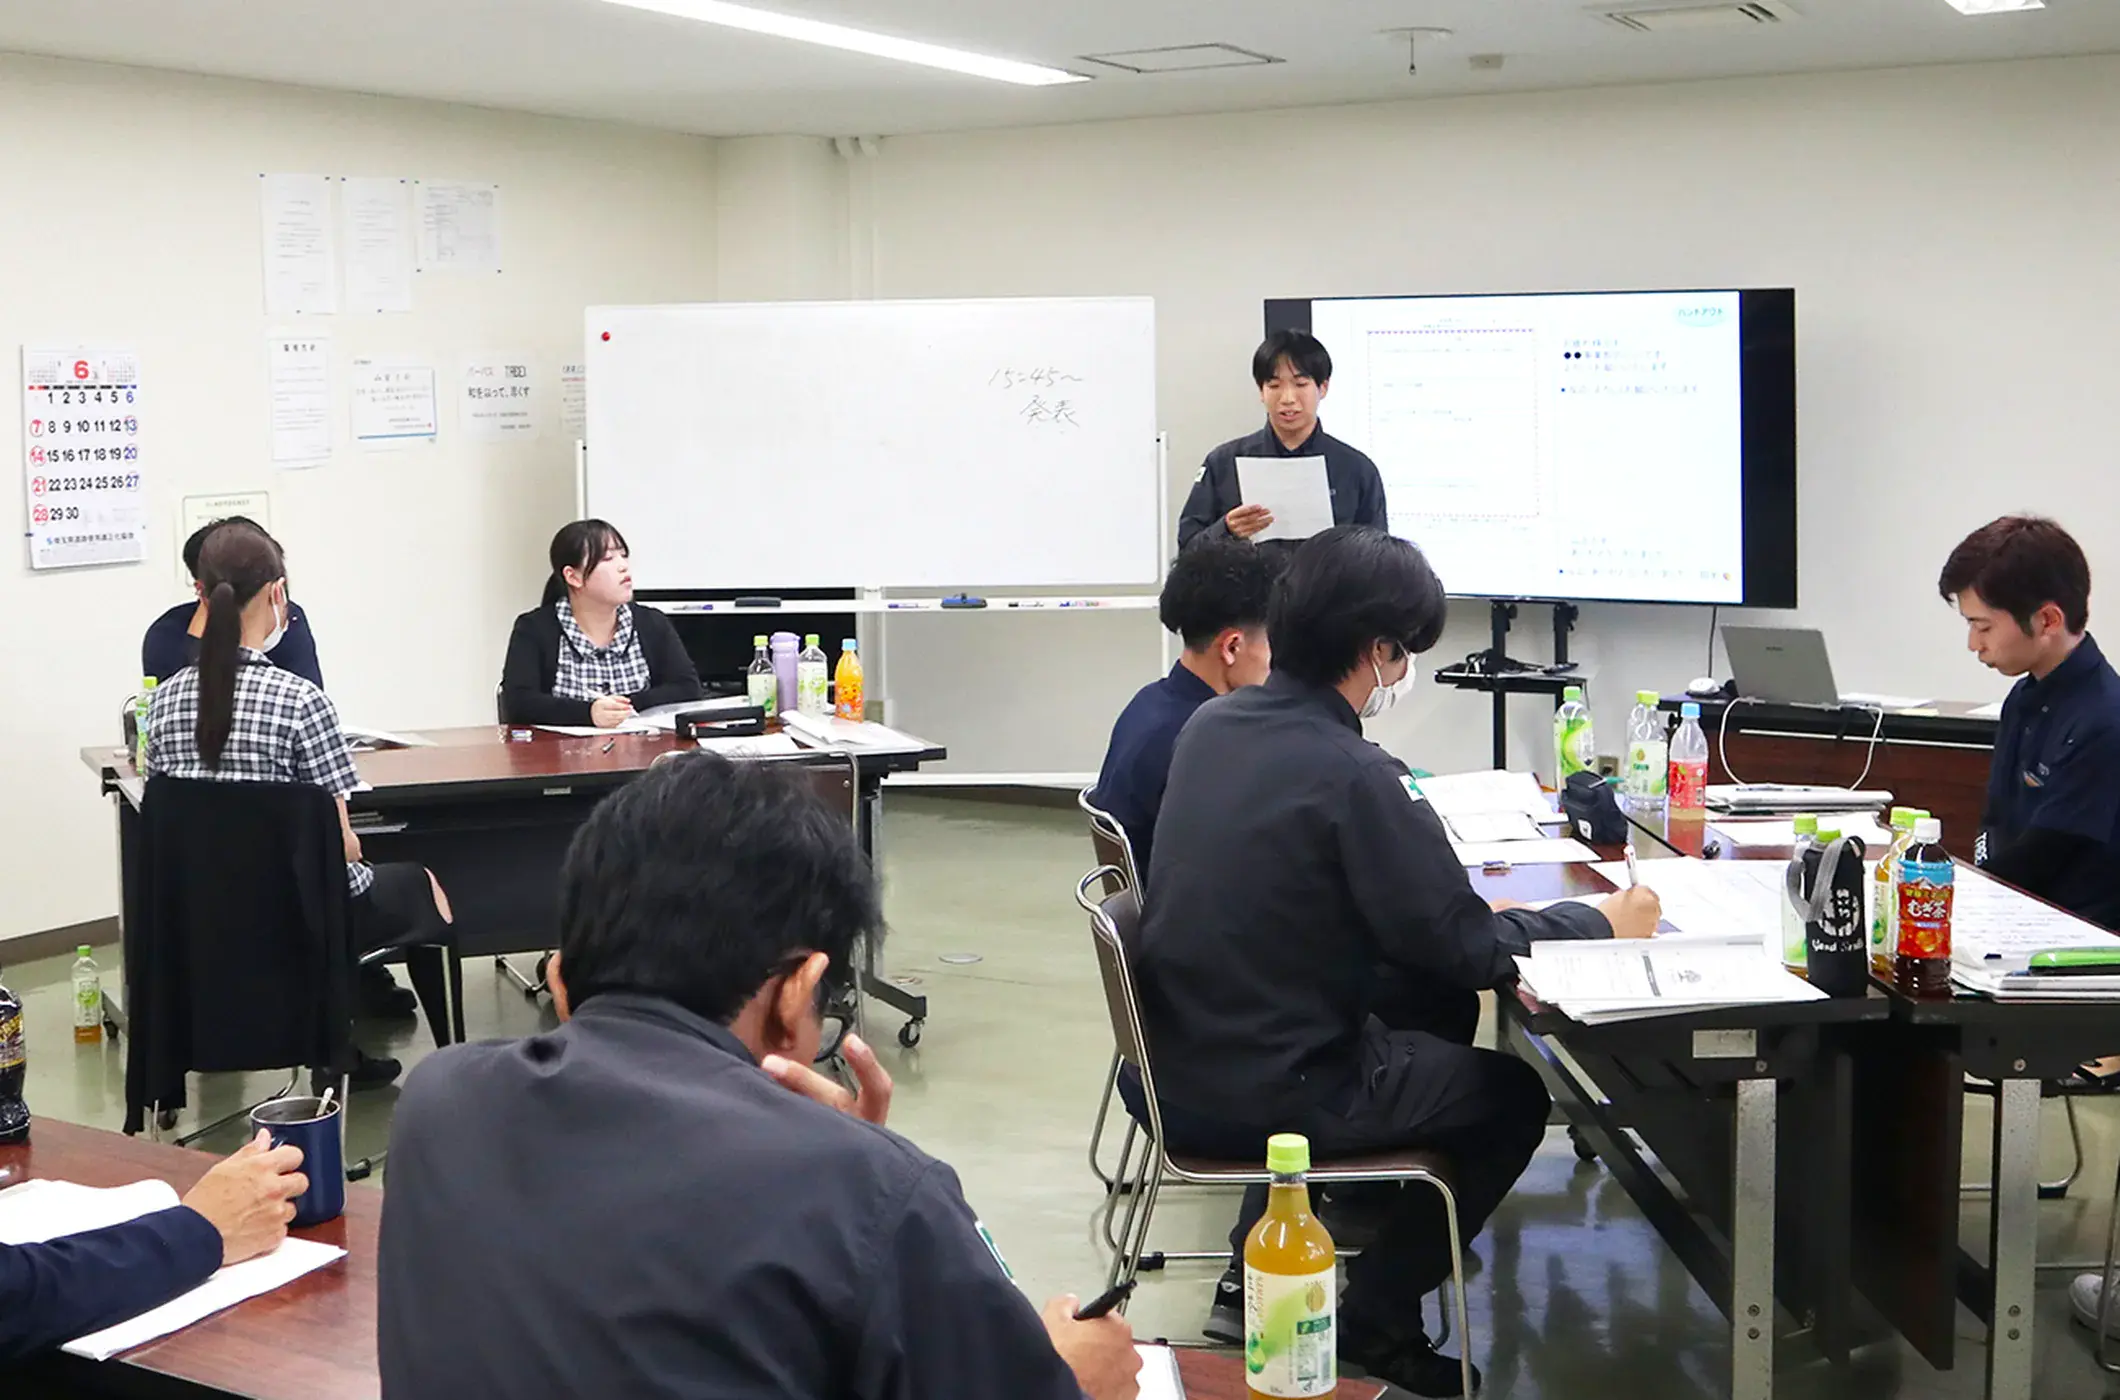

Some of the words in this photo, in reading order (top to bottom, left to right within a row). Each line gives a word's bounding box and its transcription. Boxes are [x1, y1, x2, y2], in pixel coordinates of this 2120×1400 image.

[74, 360, 90, 379] 6
[48, 392, 54, 404] 1
[63, 392, 70, 404] 2
[78, 391, 86, 404] 3
[94, 391, 102, 403] 4
[110, 391, 118, 403] 5
[126, 391, 134, 403] 6
[32, 419, 41, 433] 7
[48, 420, 56, 433] 8
[63, 420, 71, 433] 9
[77, 420, 90, 432] 10
[95, 420, 105, 432] 11
[110, 419, 121, 432] 12
[124, 419, 137, 431] 13
[31, 449, 45, 462] 14
[47, 449, 59, 462] 15
[62, 449, 75, 462] 16
[78, 449, 90, 461] 17
[94, 448, 106, 461] 18
[109, 447, 121, 460] 19
[124, 447, 137, 459] 20
[32, 479, 46, 492] 21
[49, 479, 61, 491] 22
[63, 478, 77, 490] 23
[79, 478, 93, 490] 24
[95, 476, 108, 489] 25
[110, 476, 124, 488] 26
[125, 475, 139, 487] 27
[33, 508, 48, 522] 28
[50, 508, 63, 521] 29
[65, 507, 79, 519] 30
[1907, 899, 1947, 918] むぎ茶
